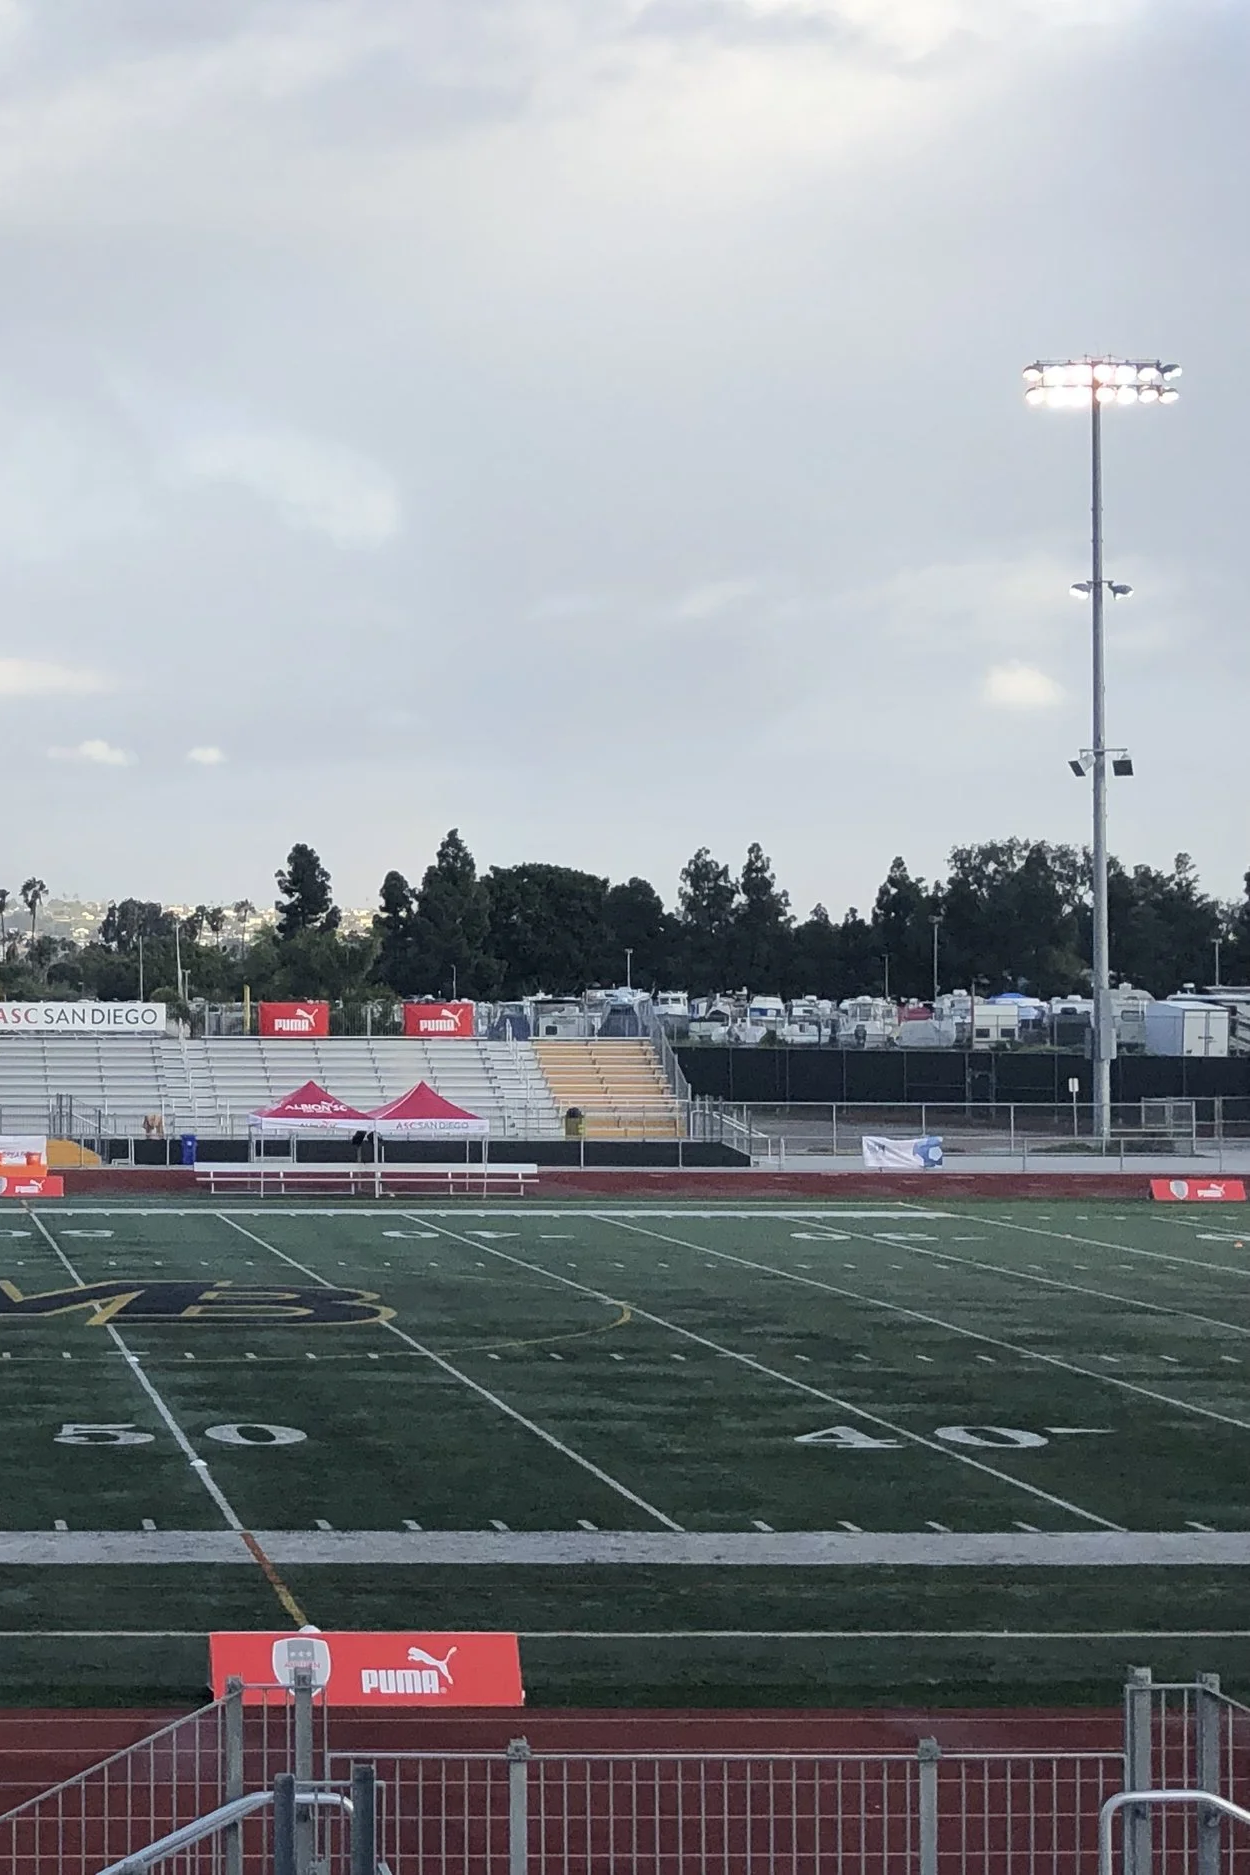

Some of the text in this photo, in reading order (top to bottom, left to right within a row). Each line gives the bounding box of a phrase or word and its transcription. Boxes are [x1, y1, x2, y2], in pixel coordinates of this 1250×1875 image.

[43, 1008, 86, 1024] SAN
[91, 1008, 158, 1025] DIEGO
[274, 1019, 310, 1031] PUMA
[419, 1019, 455, 1032] PUMA
[285, 1102, 332, 1113] ALBION
[53, 1423, 307, 1446] 50
[361, 1669, 440, 1694] PUMA
